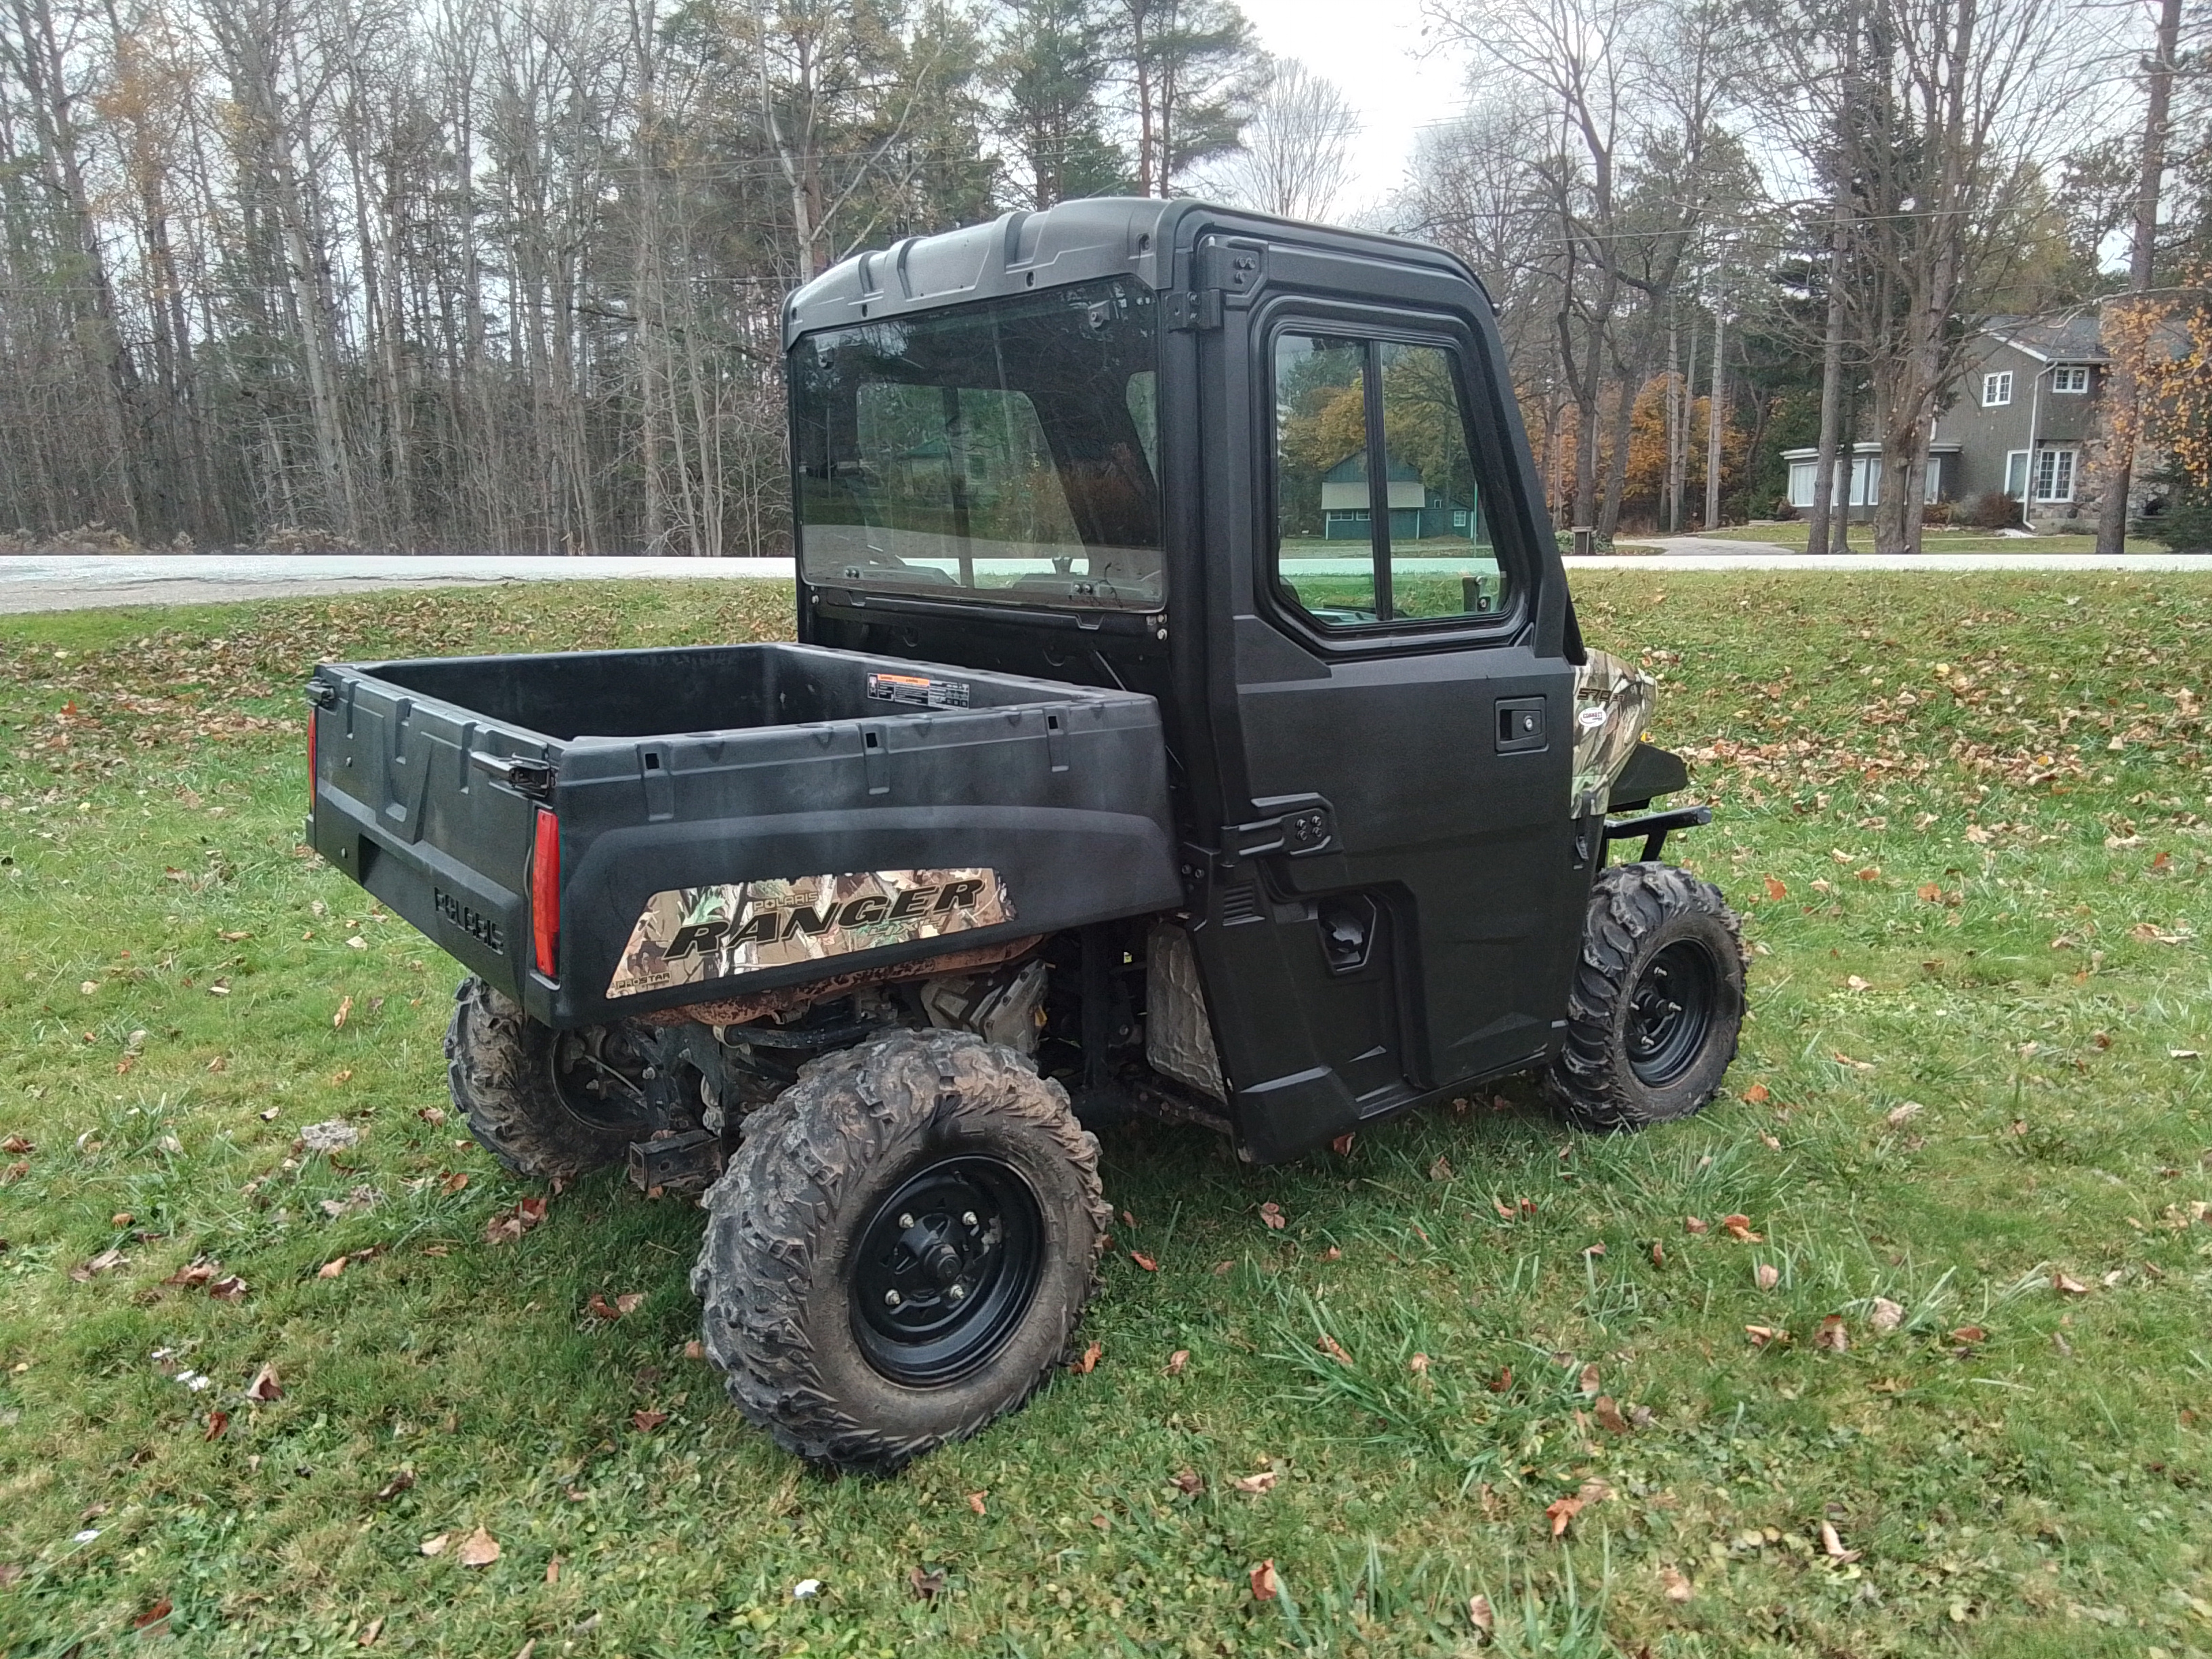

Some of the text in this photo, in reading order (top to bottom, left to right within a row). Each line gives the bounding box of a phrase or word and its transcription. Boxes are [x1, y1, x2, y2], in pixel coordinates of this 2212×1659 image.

[434, 887, 504, 954] POLARIS
[663, 879, 985, 960] RANGER
[753, 892, 818, 911] POLARIS
[617, 972, 670, 989] PROSTAR
